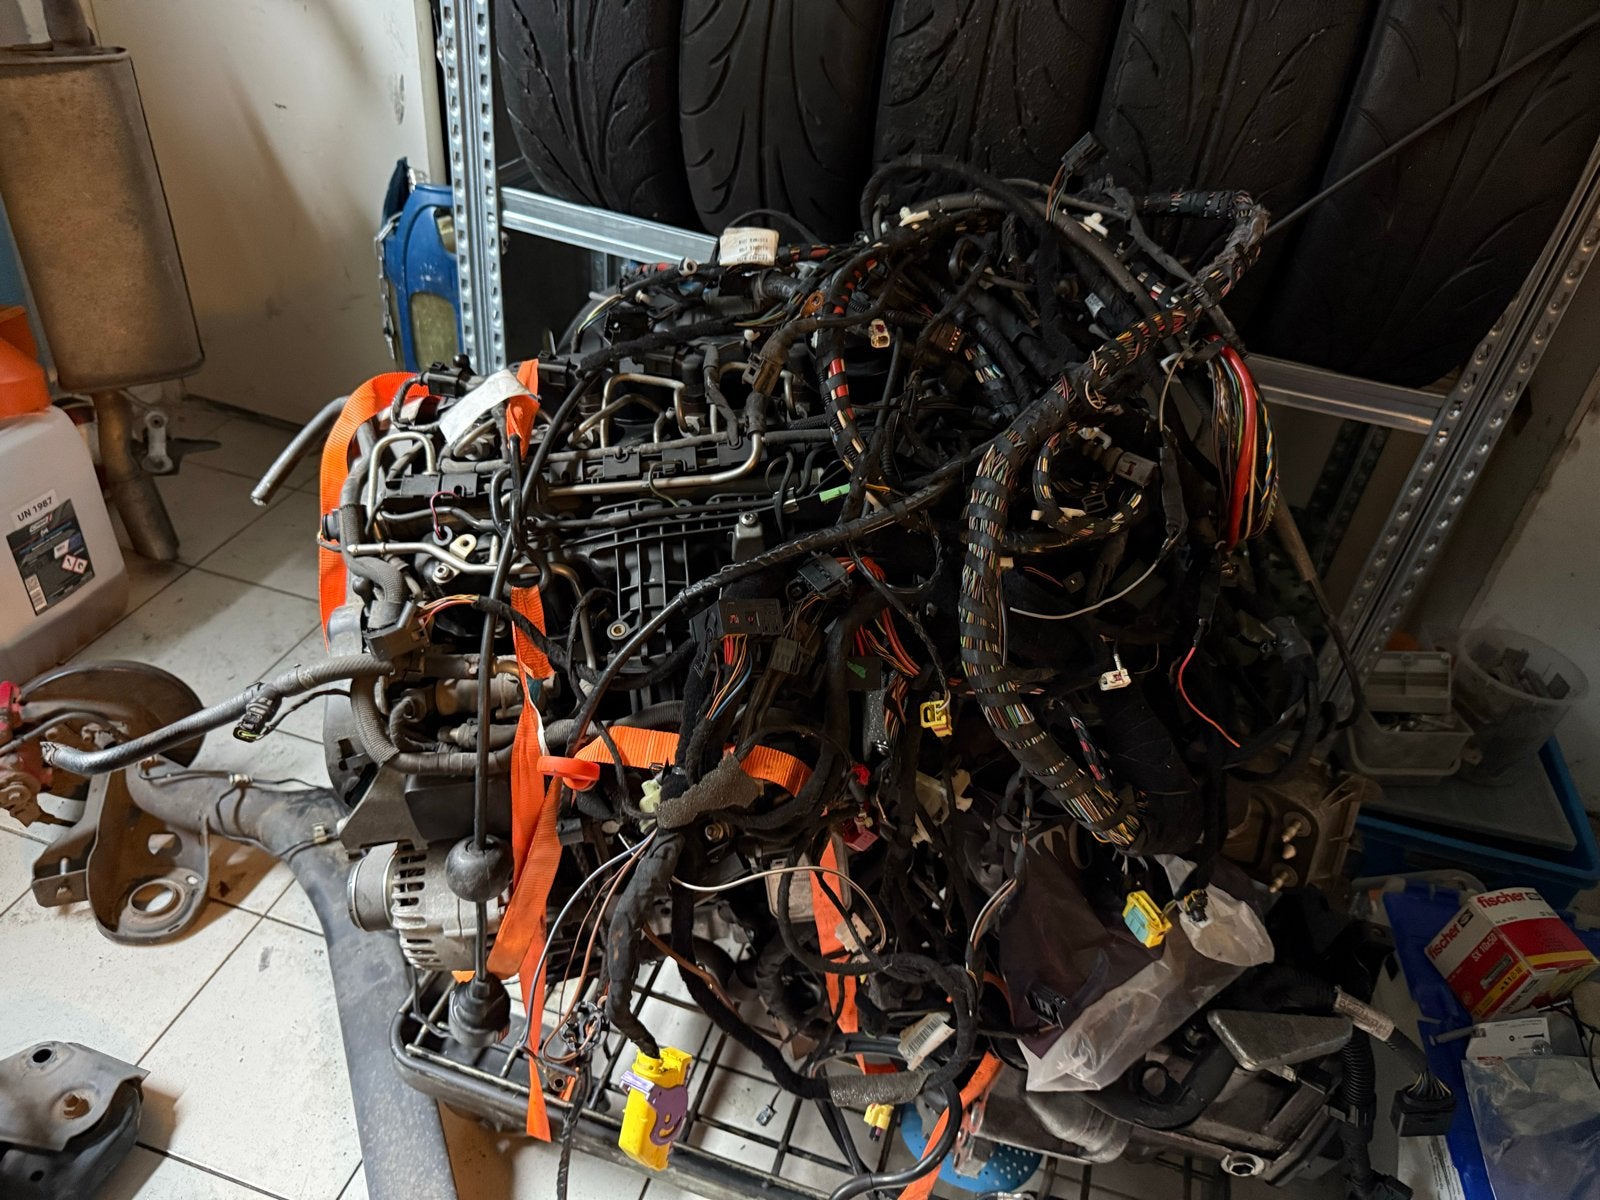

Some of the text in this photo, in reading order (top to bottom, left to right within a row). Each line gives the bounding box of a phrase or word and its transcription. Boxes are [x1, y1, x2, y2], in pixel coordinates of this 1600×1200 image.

[17, 496, 53, 522] UN 1987
[1477, 892, 1527, 908] fischer
[1429, 923, 1461, 960] fischer
[1471, 949, 1483, 962] SX
